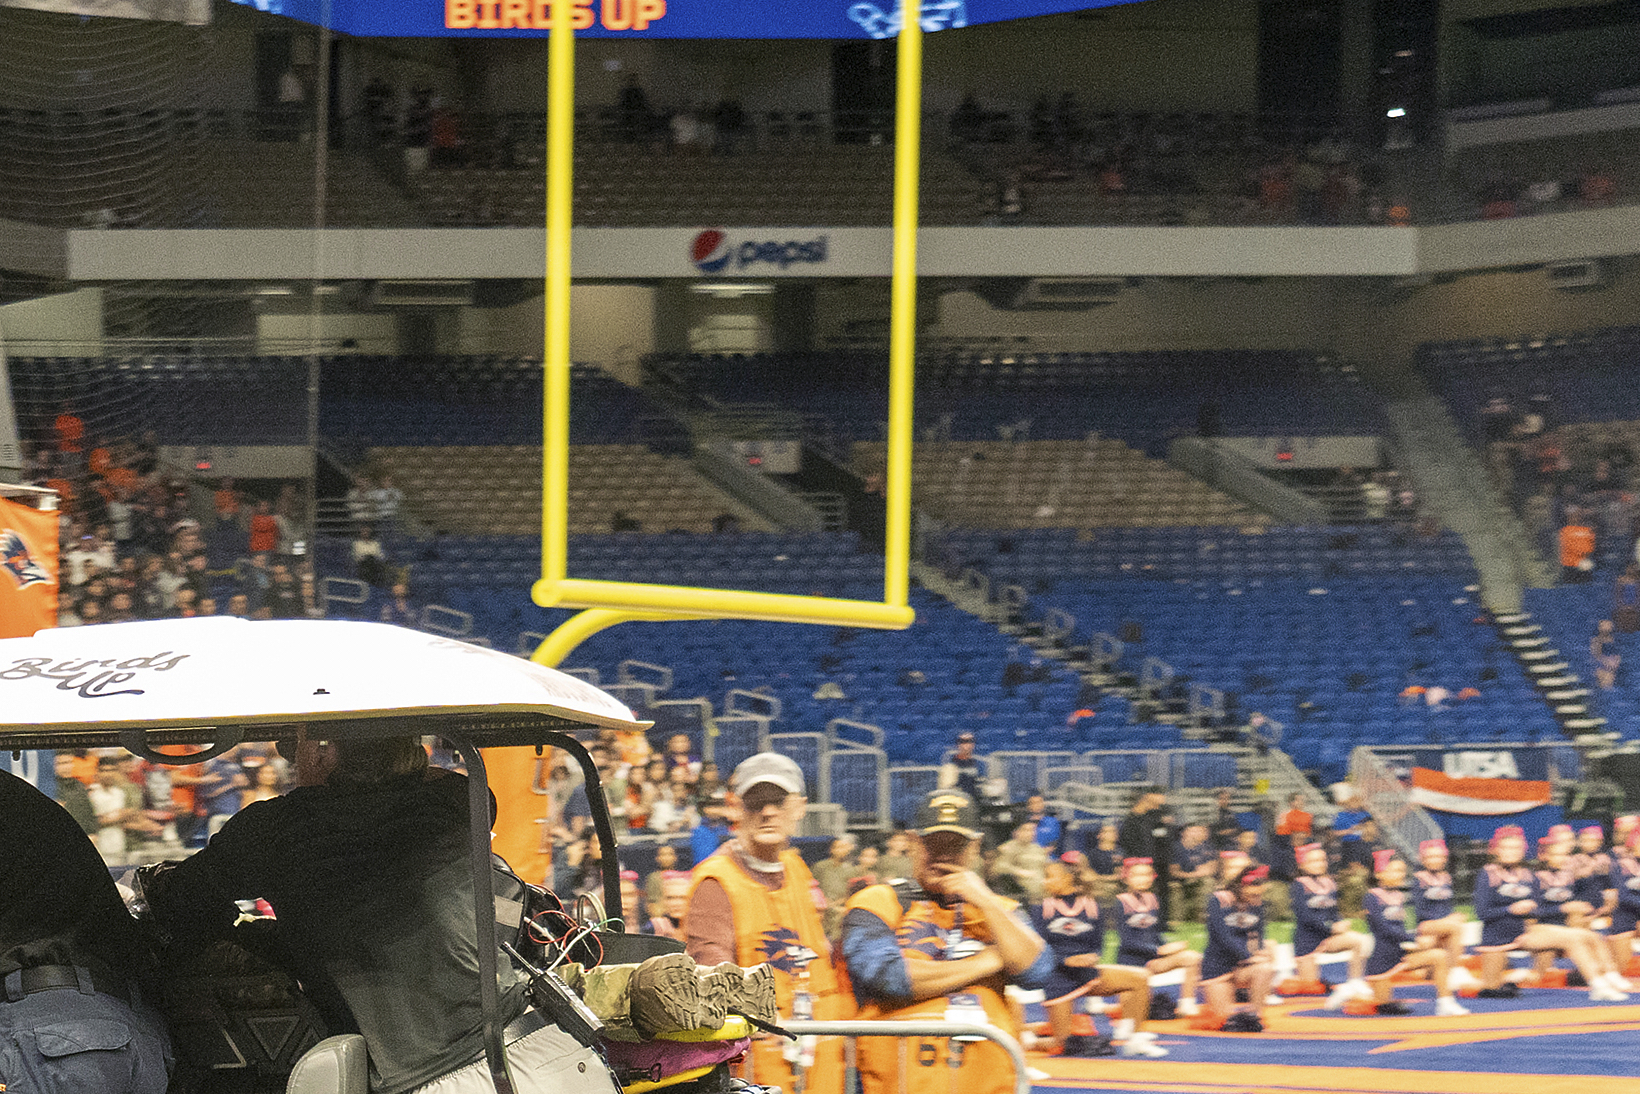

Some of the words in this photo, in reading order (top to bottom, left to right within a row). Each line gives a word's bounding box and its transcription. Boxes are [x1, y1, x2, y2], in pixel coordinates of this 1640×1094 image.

[445, 0, 596, 29] BIRDS
[600, 0, 667, 30] UP
[736, 235, 827, 269] pepsi
